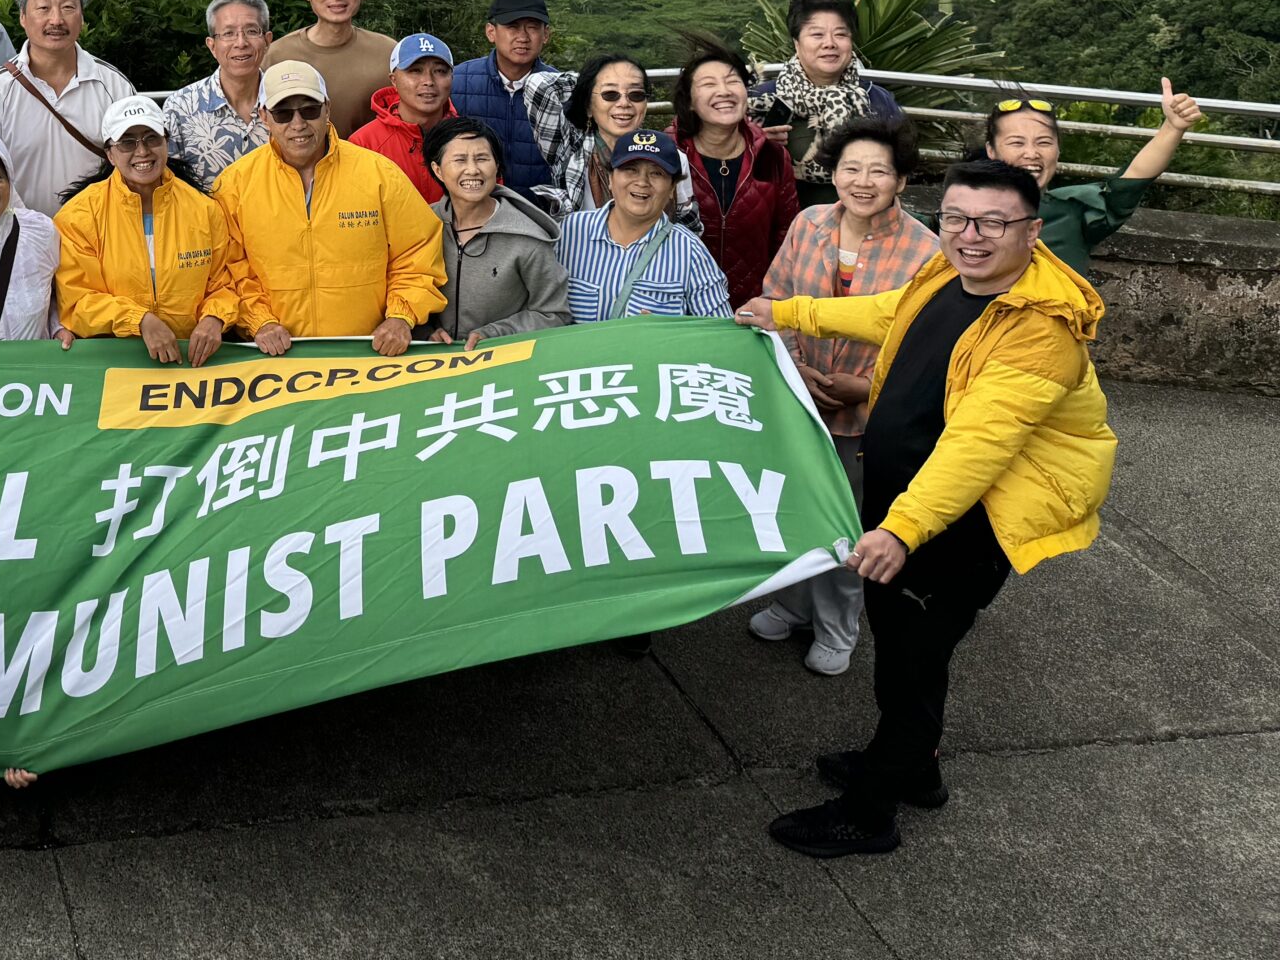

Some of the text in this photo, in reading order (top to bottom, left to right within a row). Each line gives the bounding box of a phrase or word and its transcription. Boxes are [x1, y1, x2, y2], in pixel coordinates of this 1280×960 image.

[418, 37, 435, 52] LA
[124, 107, 145, 117] run
[628, 144, 660, 153] END CCP
[338, 209, 379, 220] FALUN DAFA HAO
[138, 349, 495, 411] ENDCCP.COM
[92, 362, 763, 557] 打倒中共恶魔
[420, 459, 788, 600] PARTY
